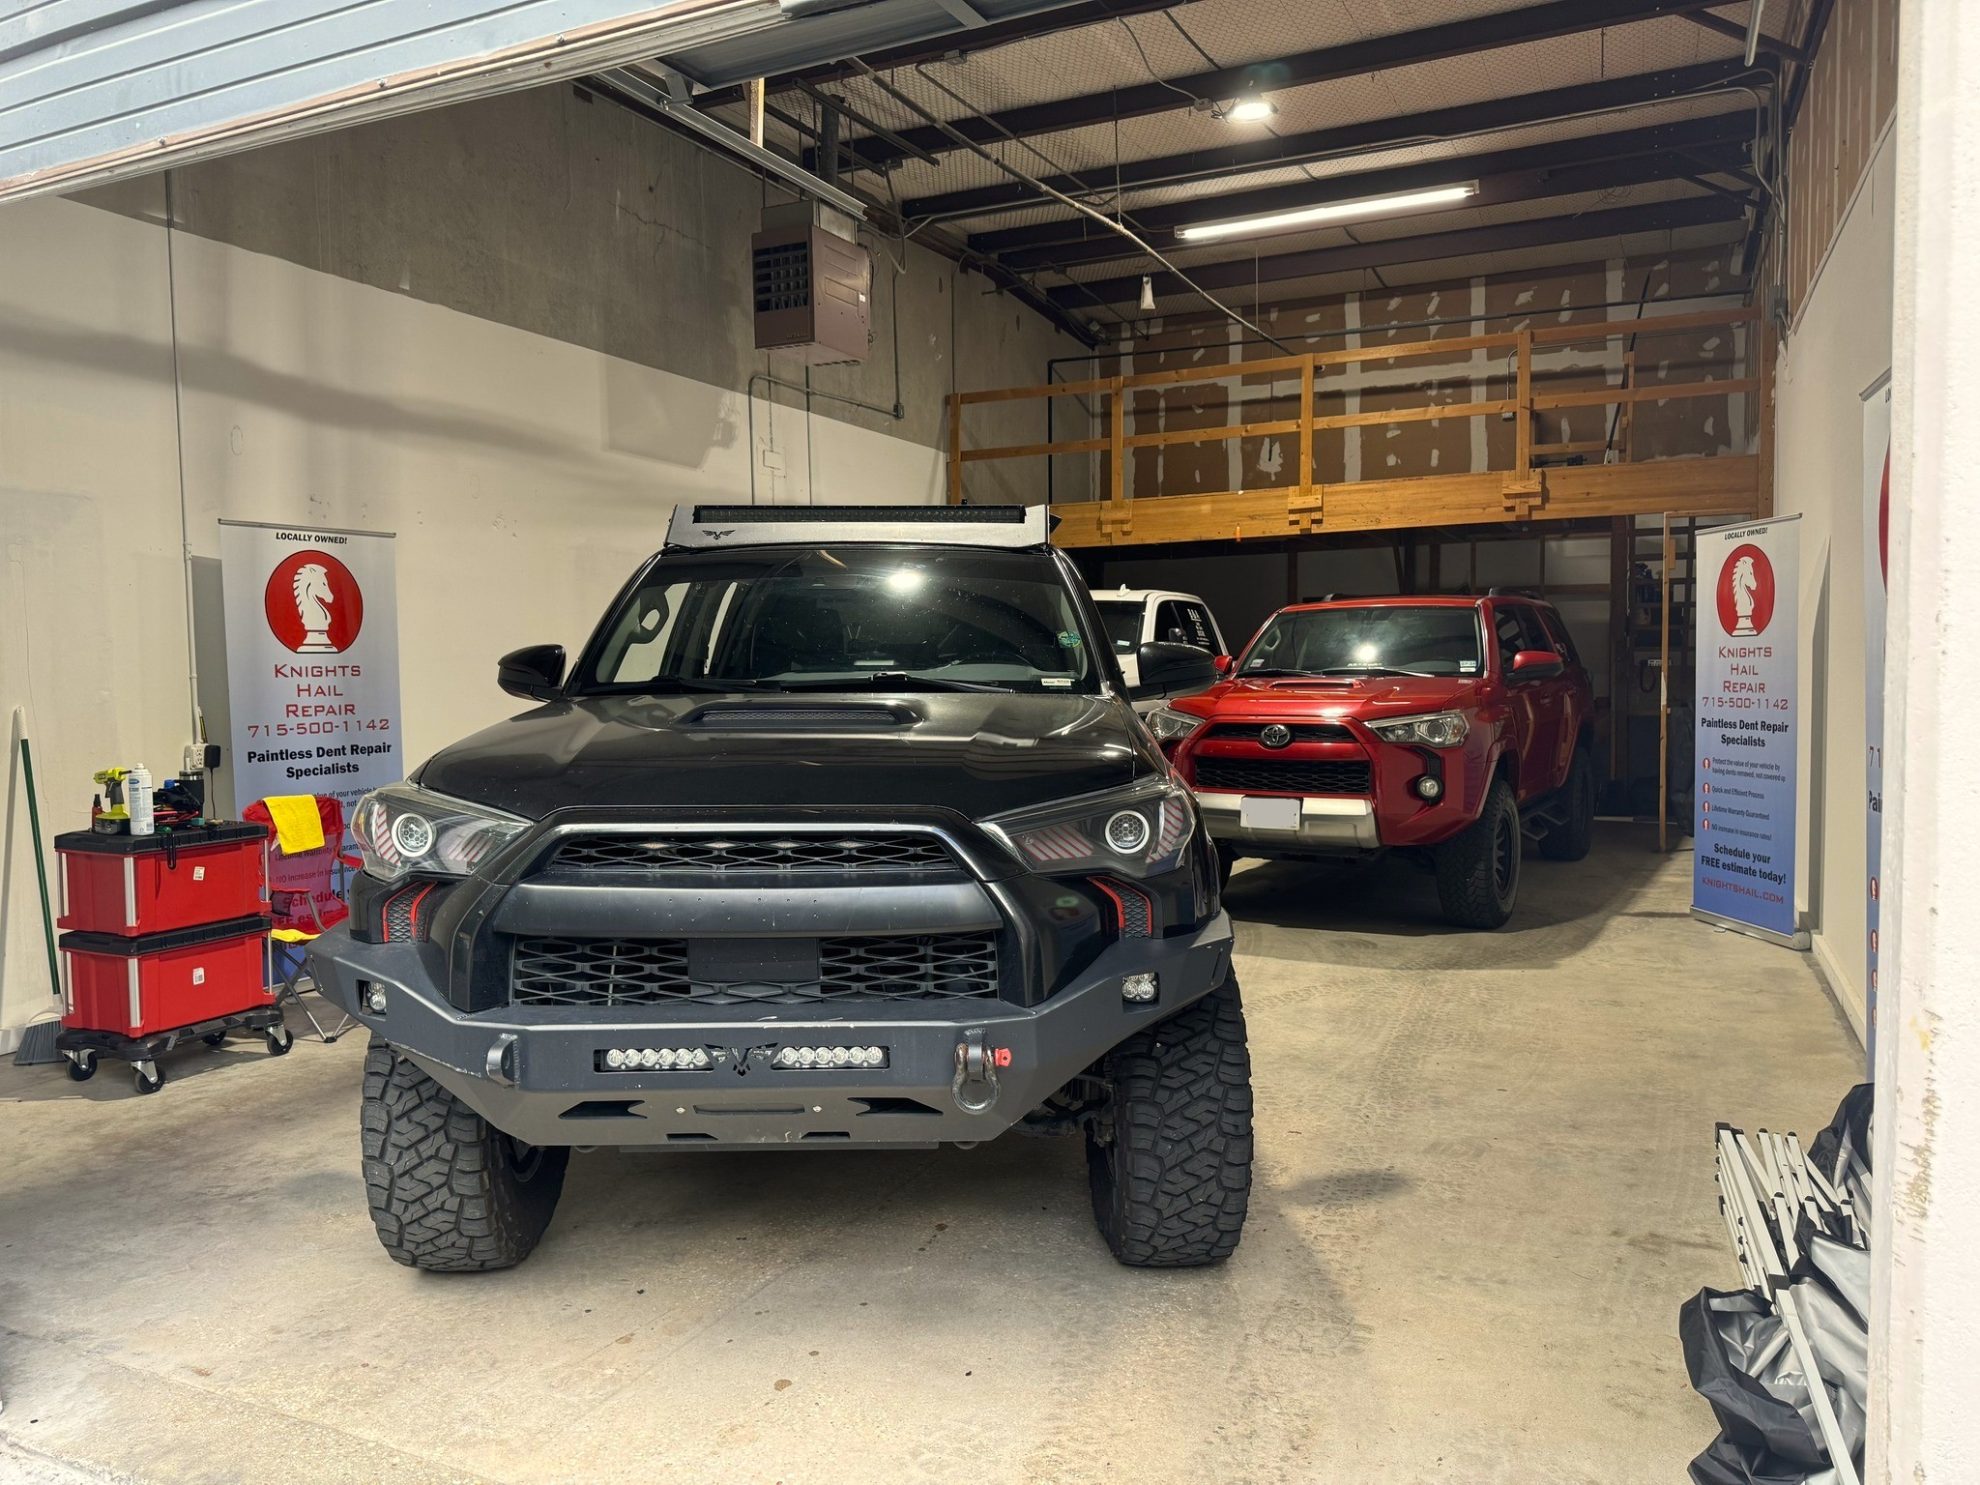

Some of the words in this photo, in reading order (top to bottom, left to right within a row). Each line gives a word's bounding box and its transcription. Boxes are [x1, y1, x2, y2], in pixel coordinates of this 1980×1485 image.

[276, 532, 312, 542] LOCALLY
[314, 534, 348, 545] OWNED!
[1724, 531, 1746, 541] LOCALLY
[1746, 527, 1768, 537] OWNED!
[1718, 646, 1772, 659] KNIGHTS
[274, 664, 361, 678] KNIGHTS
[1730, 663, 1759, 676] HAIL
[297, 683, 343, 698] HAIL
[1723, 680, 1766, 694] REPAIR
[285, 703, 356, 718] REPAIR
[1702, 696, 1789, 711] 715-500-1142
[247, 718, 390, 738] 715-500-1142
[1701, 717, 1738, 730] Paintless
[1739, 719, 1759, 731] Dent
[1760, 720, 1789, 734] Repair
[1720, 733, 1766, 747] Specialists
[247, 748, 313, 764] Paintless
[316, 745, 347, 759] Dent
[350, 742, 392, 757] Repair
[286, 762, 360, 779] Specialists
[336, 789, 349, 799] your
[1713, 843, 1751, 860] Schedule
[1751, 852, 1771, 865] your
[1701, 855, 1721, 869] FREE
[1721, 861, 1758, 878] estimate
[1758, 867, 1786, 886] today!
[1701, 876, 1785, 905] KNIGHTSHAIL.COM
